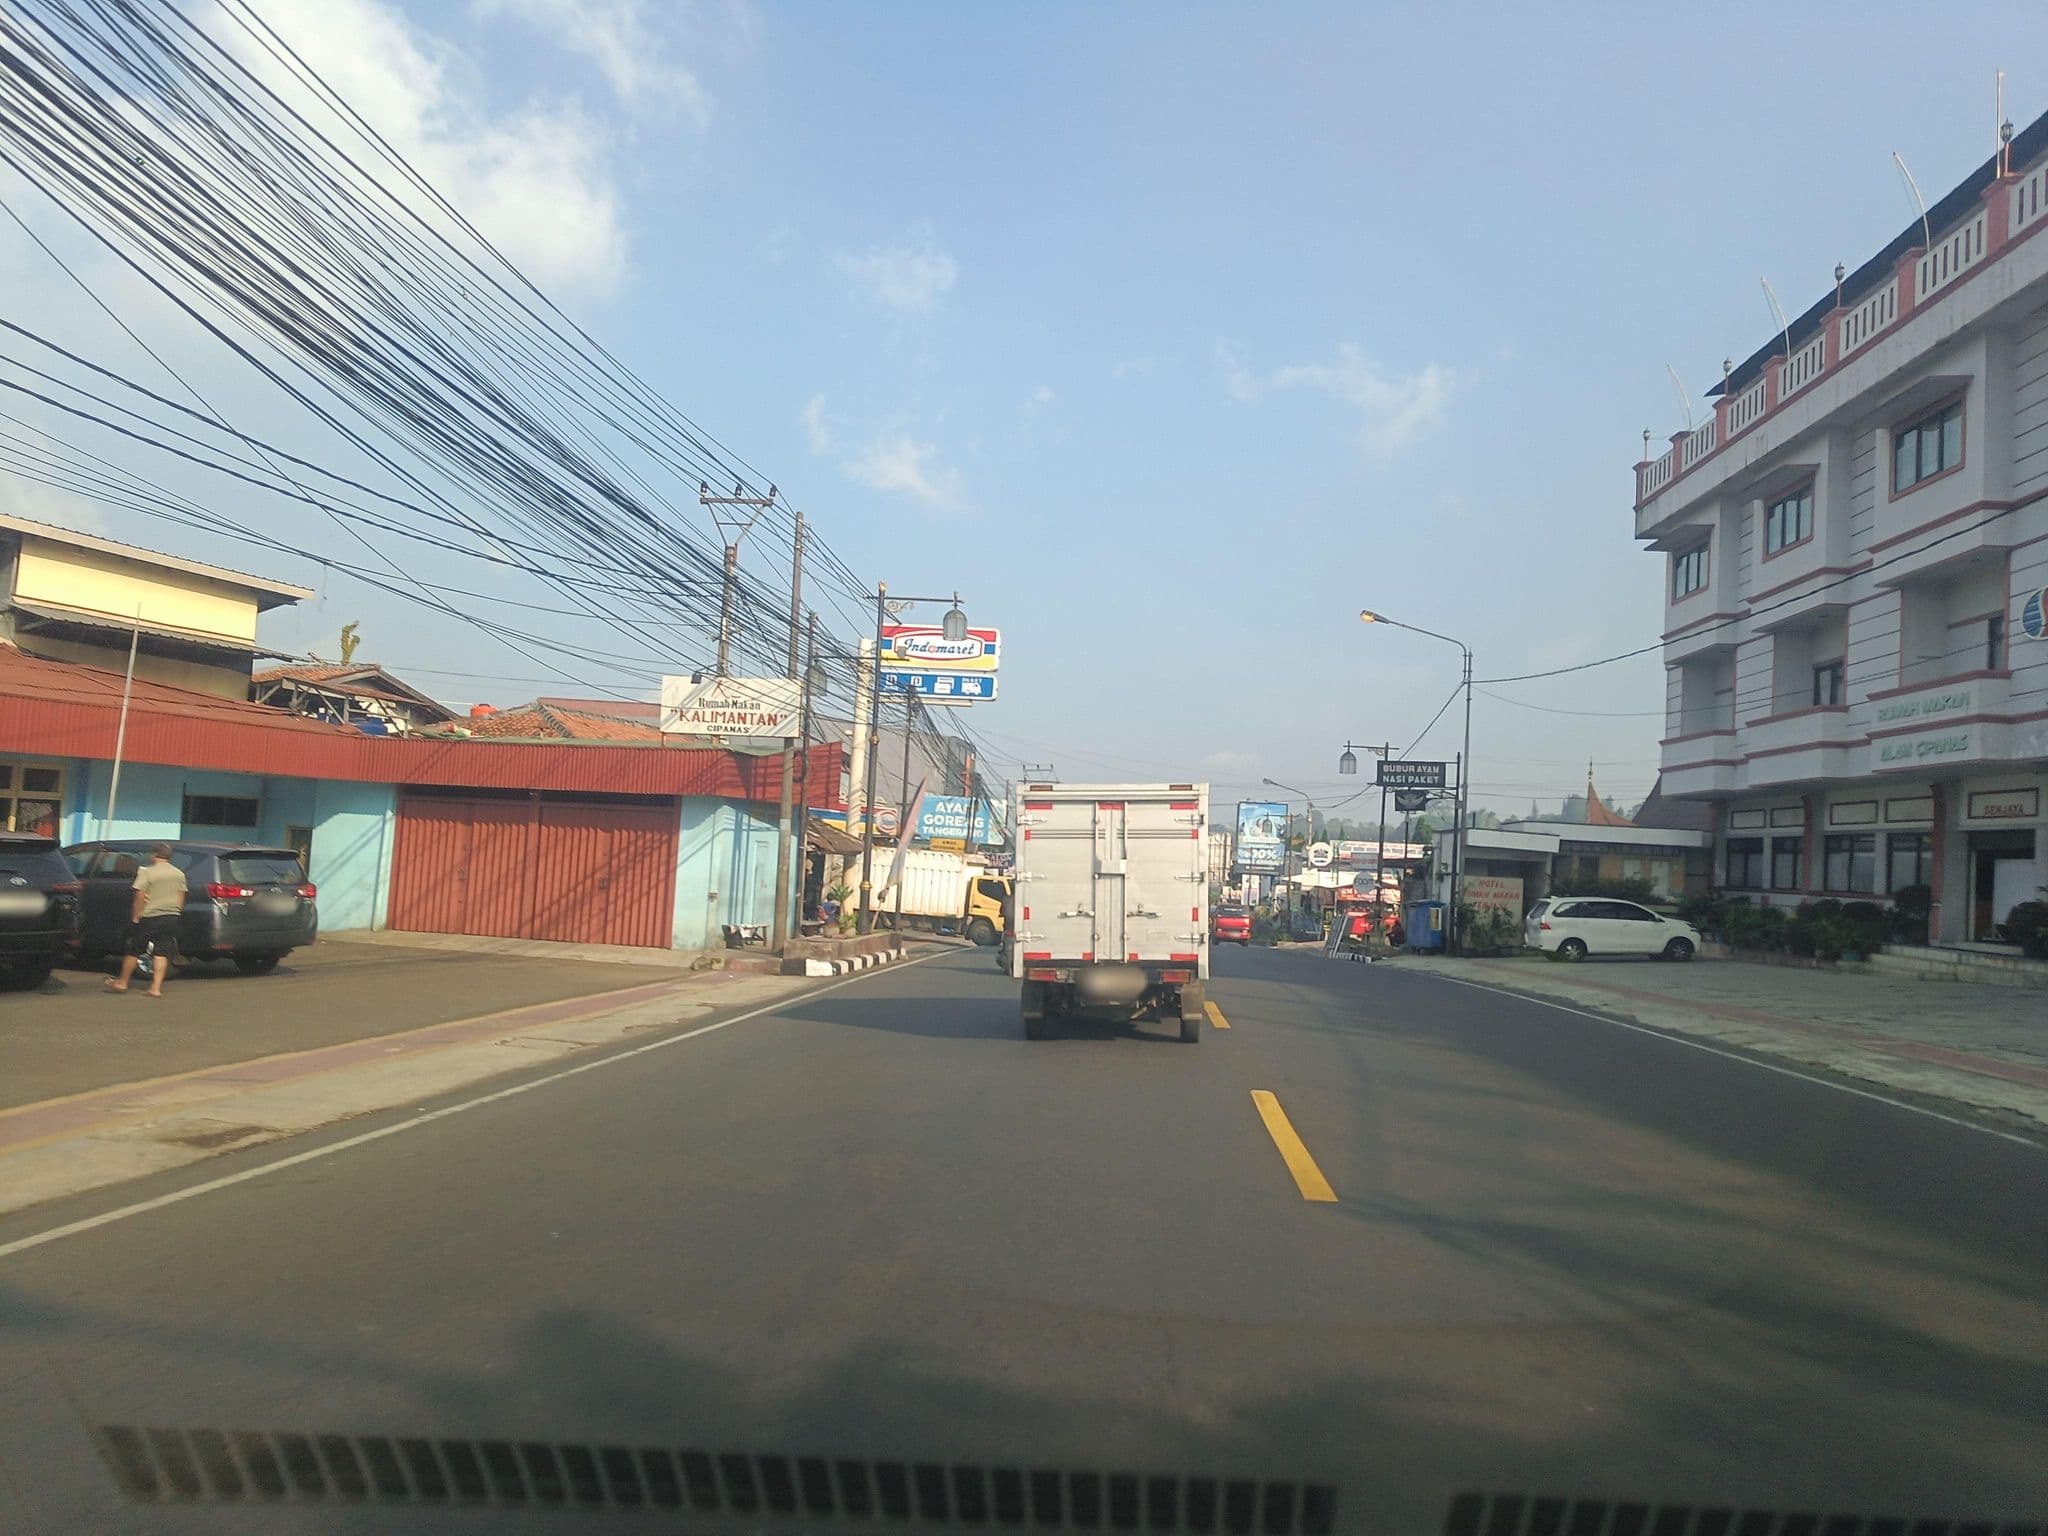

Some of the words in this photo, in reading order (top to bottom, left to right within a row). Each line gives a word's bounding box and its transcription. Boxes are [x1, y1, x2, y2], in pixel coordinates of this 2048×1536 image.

[904, 638, 975, 655] Indomaret
[698, 697, 730, 710] Rumah
[731, 699, 761, 711] Makan
[706, 725, 751, 734] CIPANAS
[1382, 764, 1415, 773] BUBUR
[1416, 765, 1440, 774] AYAM
[1382, 775, 1406, 784] NASI
[1407, 775, 1440, 784] PAKET
[935, 802, 969, 814] AYA
